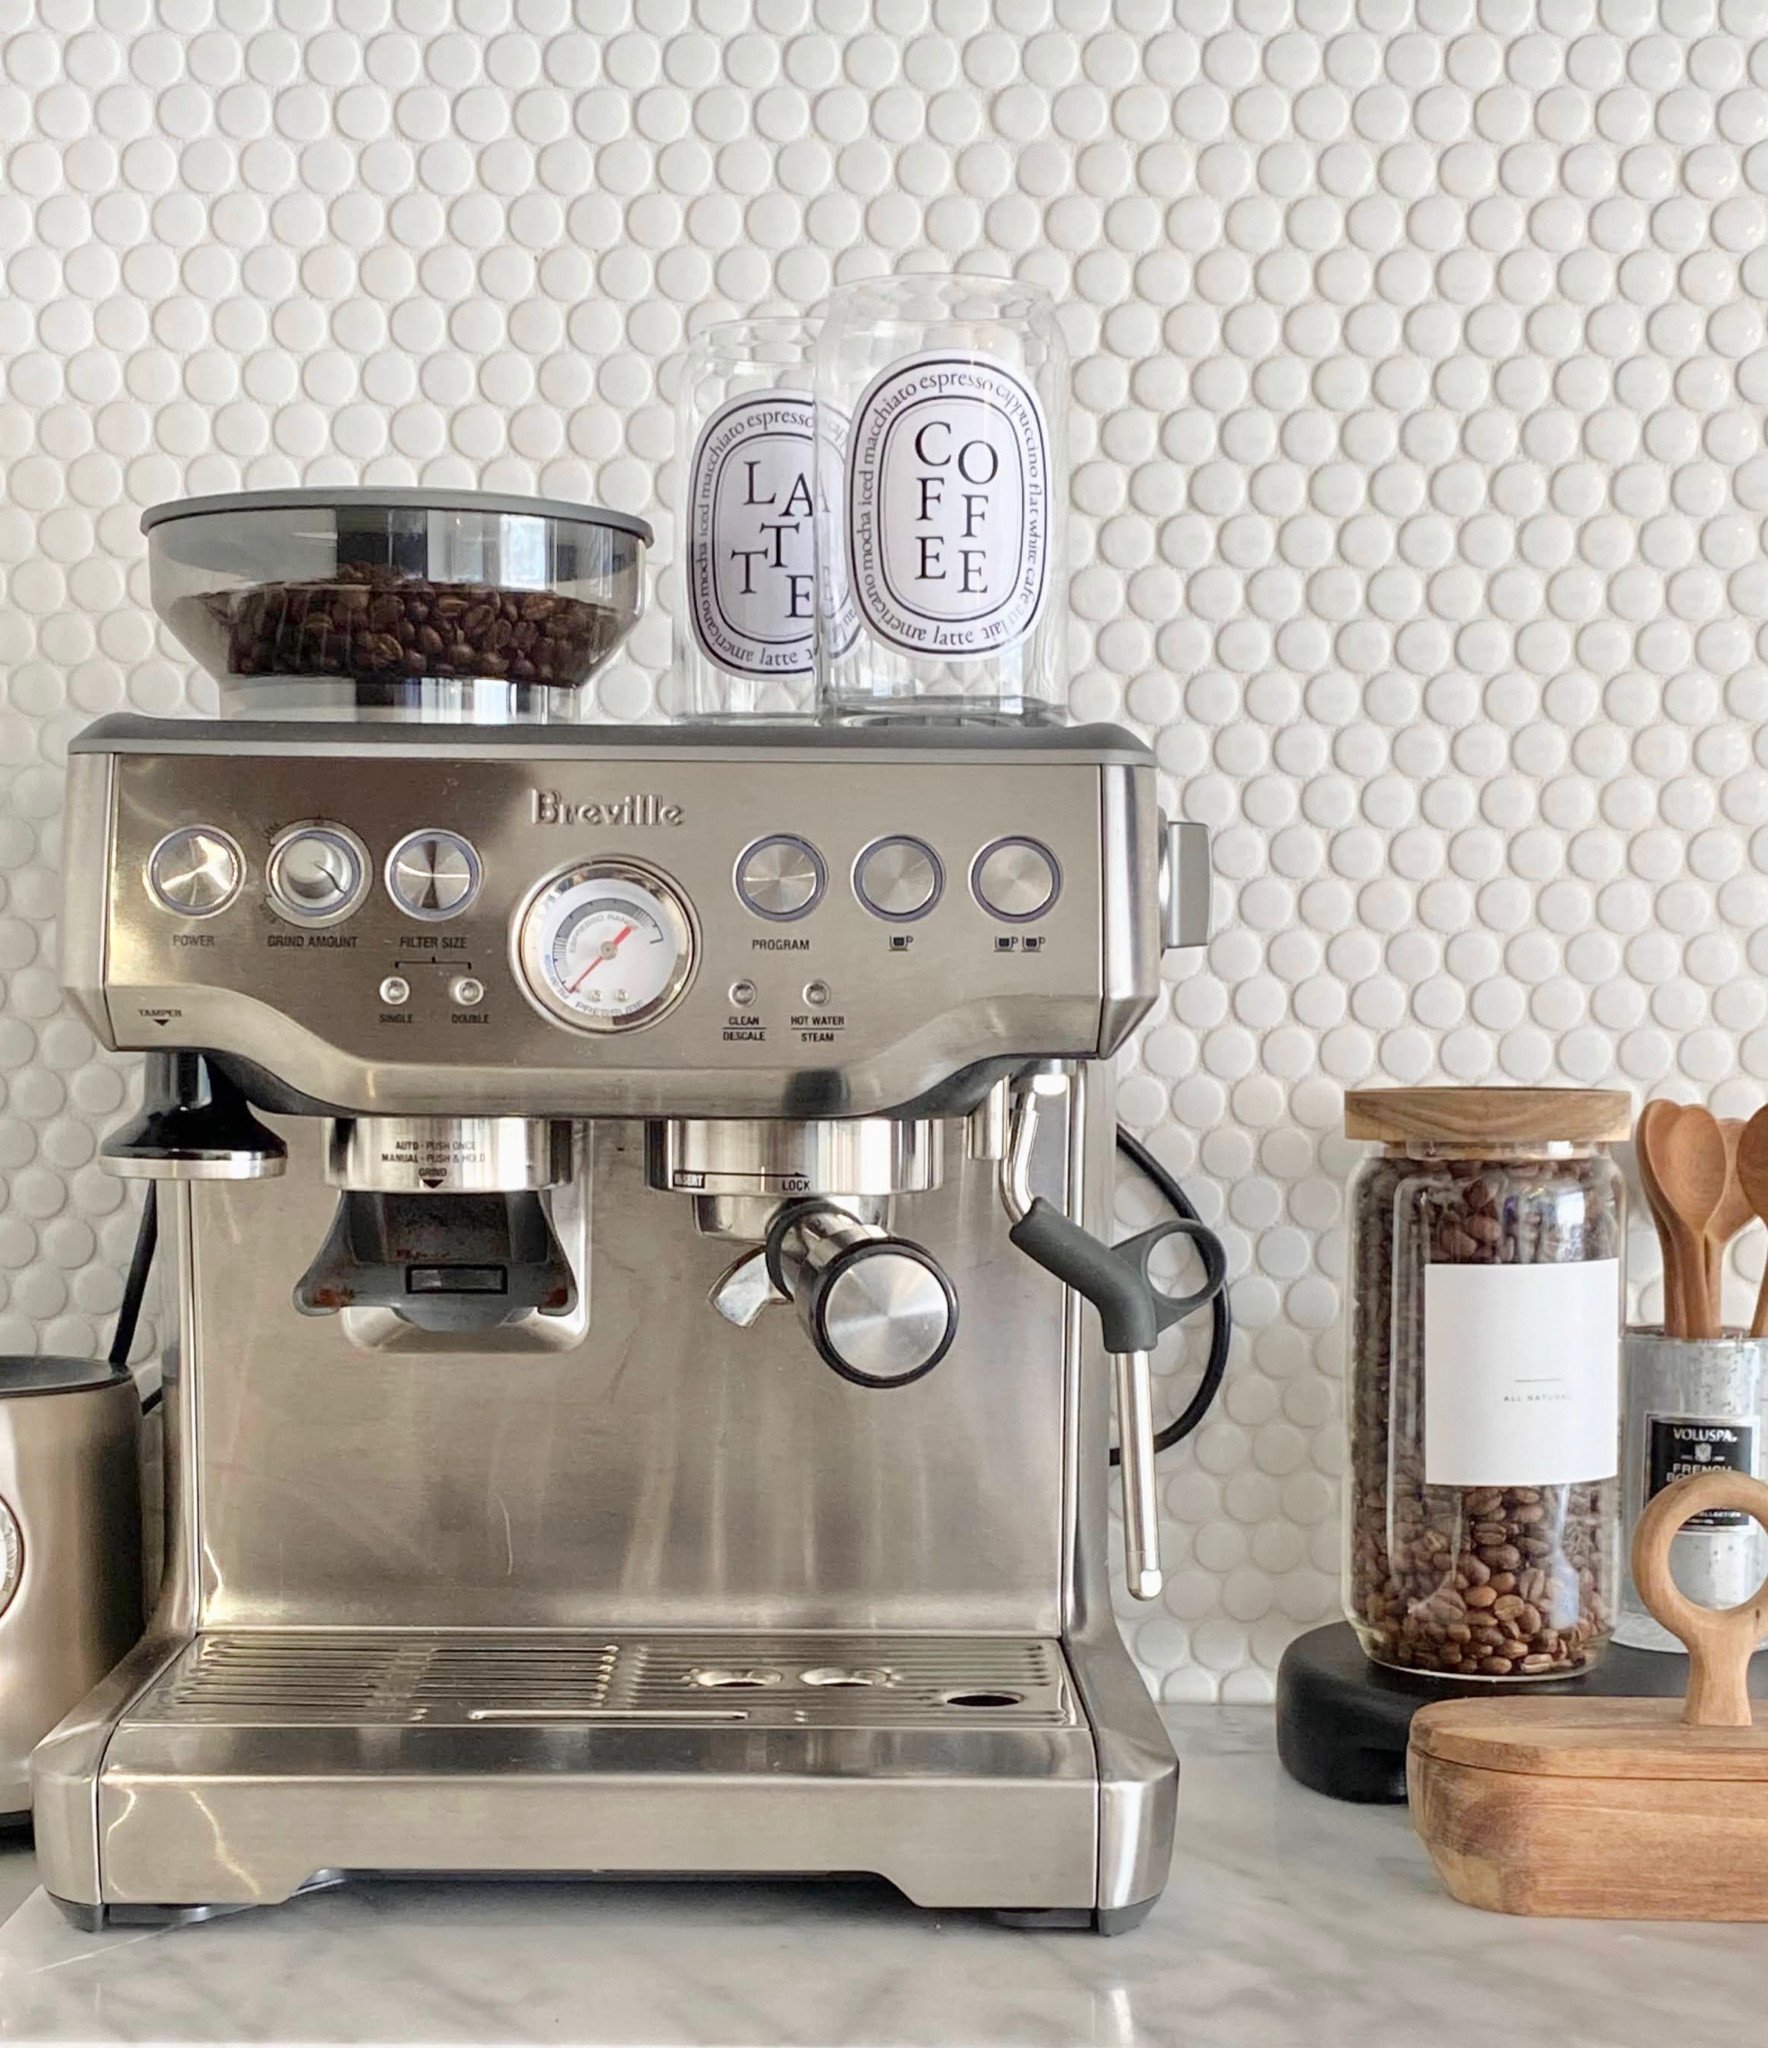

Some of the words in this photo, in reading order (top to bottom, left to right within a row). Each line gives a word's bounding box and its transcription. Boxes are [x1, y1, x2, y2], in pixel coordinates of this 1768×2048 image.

[919, 373, 994, 393] espresso
[864, 383, 917, 465] macchiato
[995, 384, 1039, 479] cappuccino
[701, 422, 745, 499] macchiato
[858, 469, 874, 507] iced
[1028, 482, 1042, 514] flat
[698, 503, 711, 536] iced
[857, 511, 874, 571] mocha
[1028, 519, 1041, 564] white
[696, 542, 710, 597] mocha
[864, 573, 927, 641] americano
[702, 600, 754, 662] americano
[932, 625, 975, 647] latte
[759, 648, 797, 666] latte
[531, 788, 685, 827] Breville
[172, 934, 216, 947] POWER
[267, 936, 303, 948] GRIND
[307, 936, 359, 949] AMOUNT
[400, 937, 439, 949] FILTER
[442, 937, 468, 949] SIZE
[752, 939, 810, 951] PROGRAM
[138, 1009, 183, 1018] TAMPER
[378, 1013, 414, 1025] SINGLE
[451, 1013, 490, 1025] DOUBLE
[728, 1016, 760, 1026] CLEAN
[790, 1016, 809, 1026] HOT
[812, 1016, 845, 1026] WATER
[723, 1031, 766, 1042] DESCALE
[801, 1033, 835, 1043] STEAM
[395, 1141, 419, 1151] AUTO
[426, 1141, 450, 1151] PUSH
[452, 1141, 476, 1151] ONCE
[381, 1153, 418, 1163] MANUAL
[426, 1154, 450, 1163] PUSH
[418, 1167, 448, 1178] GRIND
[782, 1179, 811, 1191] LOCK
